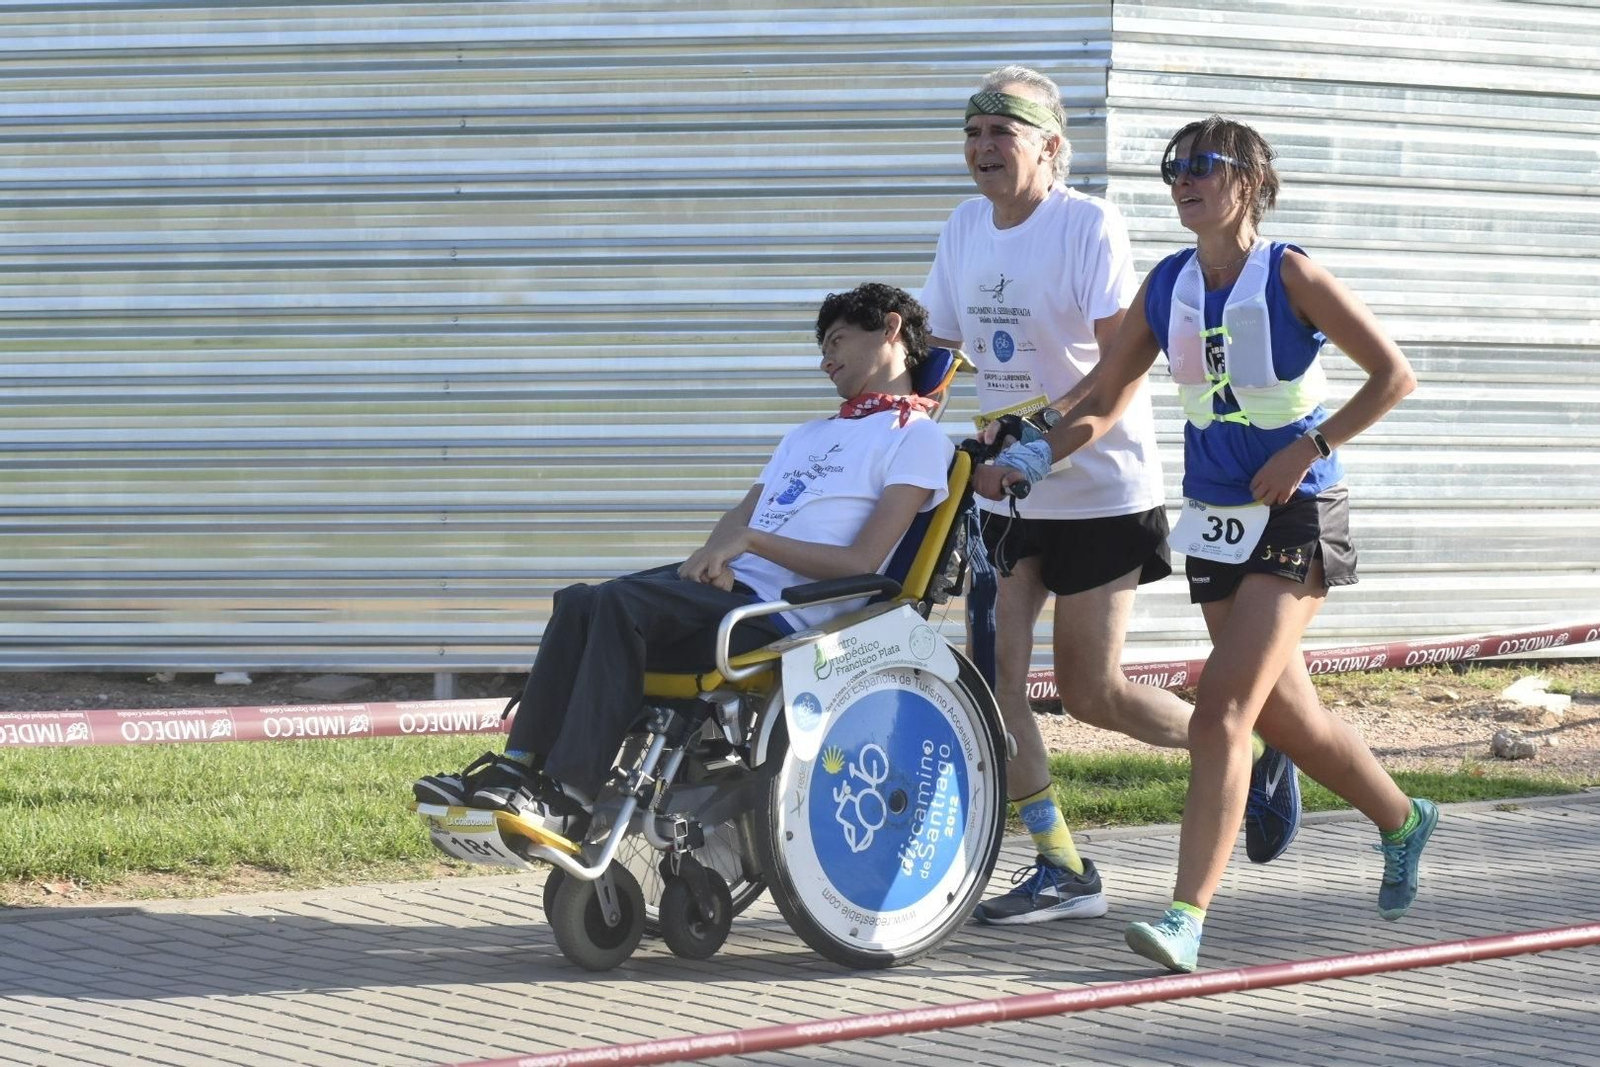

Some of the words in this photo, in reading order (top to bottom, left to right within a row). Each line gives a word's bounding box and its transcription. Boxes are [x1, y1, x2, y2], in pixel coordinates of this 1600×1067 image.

[1202, 515, 1245, 545] 30
[1405, 646, 1463, 666] IMDECO
[1497, 635, 1554, 655] IMDECO
[836, 654, 878, 677] Francisco
[878, 644, 901, 660] Plata
[1309, 656, 1369, 674] IMDECO
[0, 712, 22, 720] Deporte
[263, 716, 346, 738] IMDECO
[399, 711, 478, 734] IMDECO
[851, 672, 898, 696] Española
[899, 672, 912, 686] de
[913, 676, 948, 710] Turismo
[946, 706, 974, 762] Accesible
[121, 720, 208, 741] IMDECO
[898, 739, 935, 877] discamino
[944, 796, 960, 837] 2012
[451, 836, 506, 858] 181
[821, 887, 917, 929] www.redestable.com
